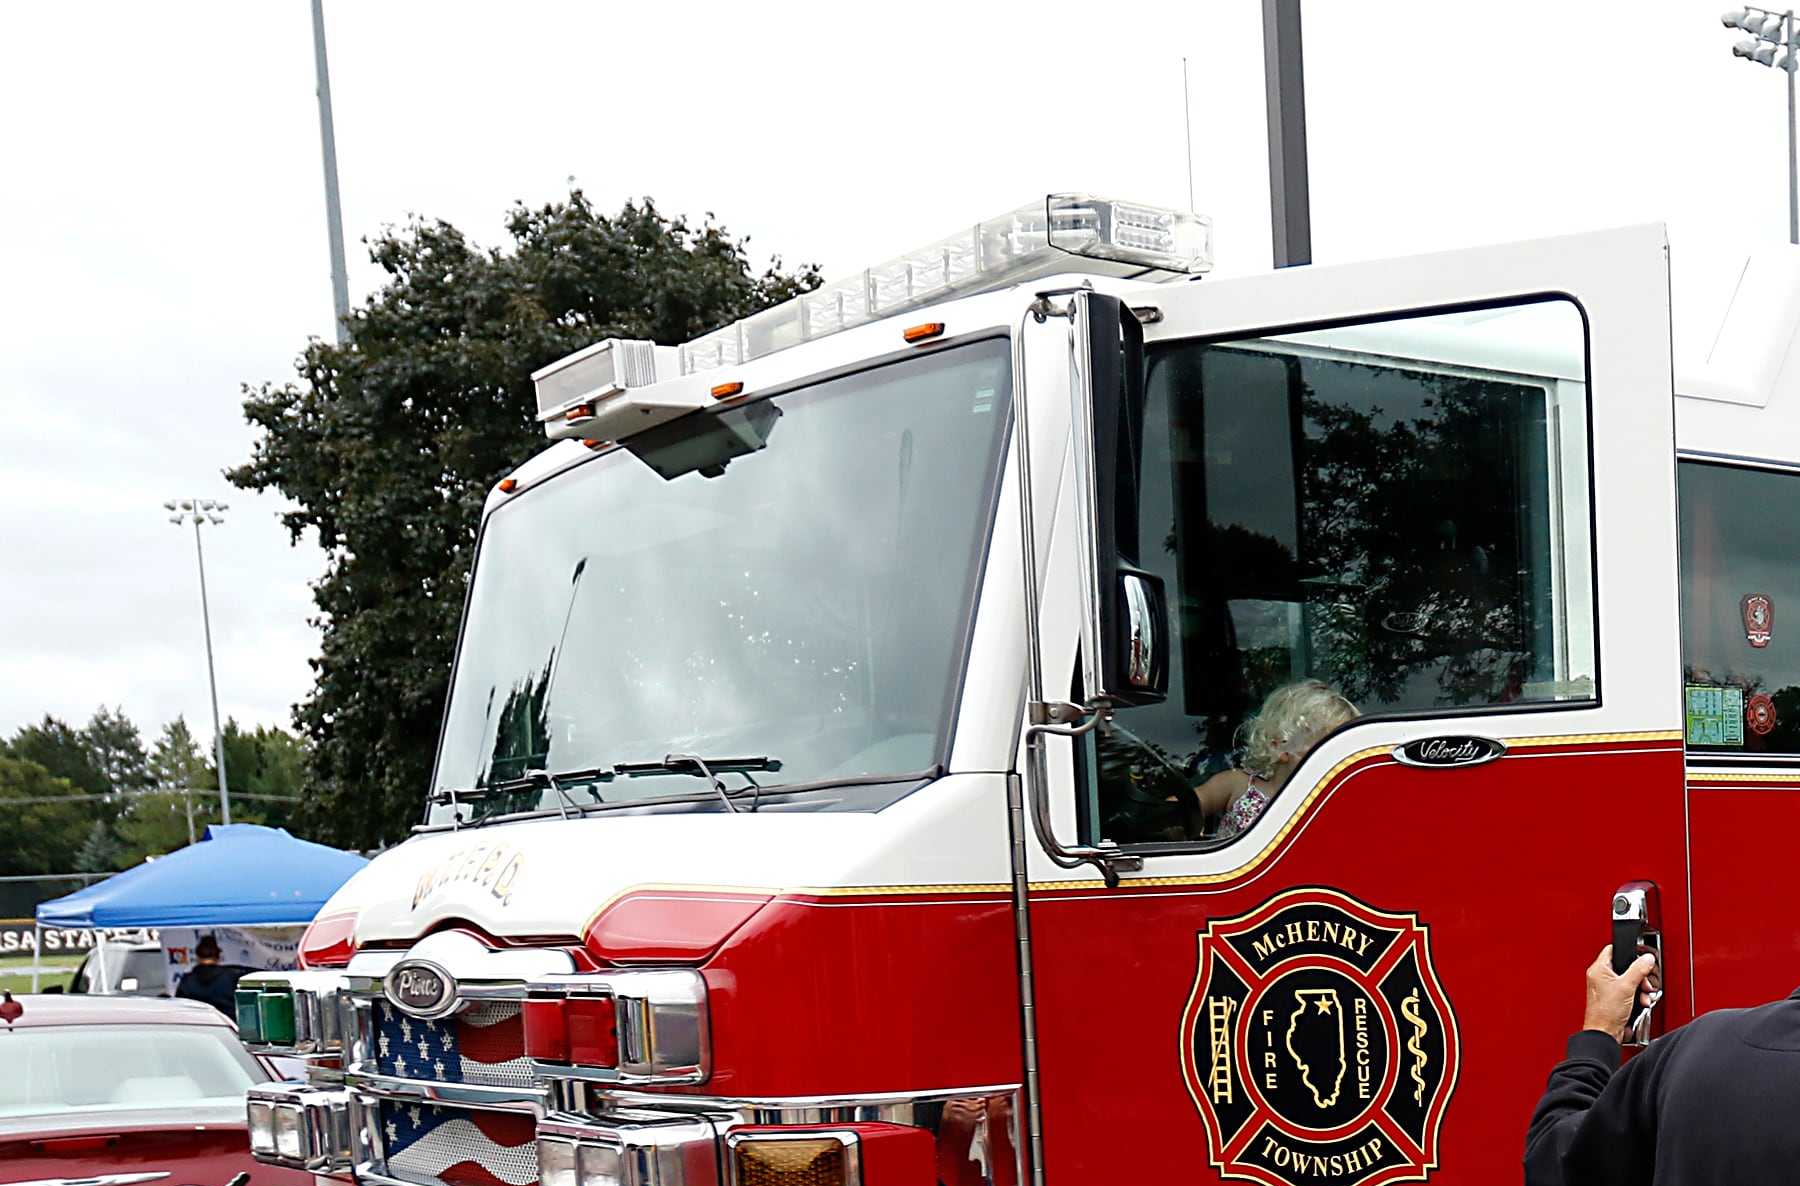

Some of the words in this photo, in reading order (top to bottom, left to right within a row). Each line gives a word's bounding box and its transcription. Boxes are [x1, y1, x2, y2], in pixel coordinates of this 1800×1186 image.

[1420, 740, 1480, 761] Velocity
[1251, 920, 1374, 961] McHENRY
[1263, 1009, 1278, 1089] FIRE
[1354, 998, 1370, 1098] RESCUE
[1261, 1136, 1383, 1177] TOWNSHIP
